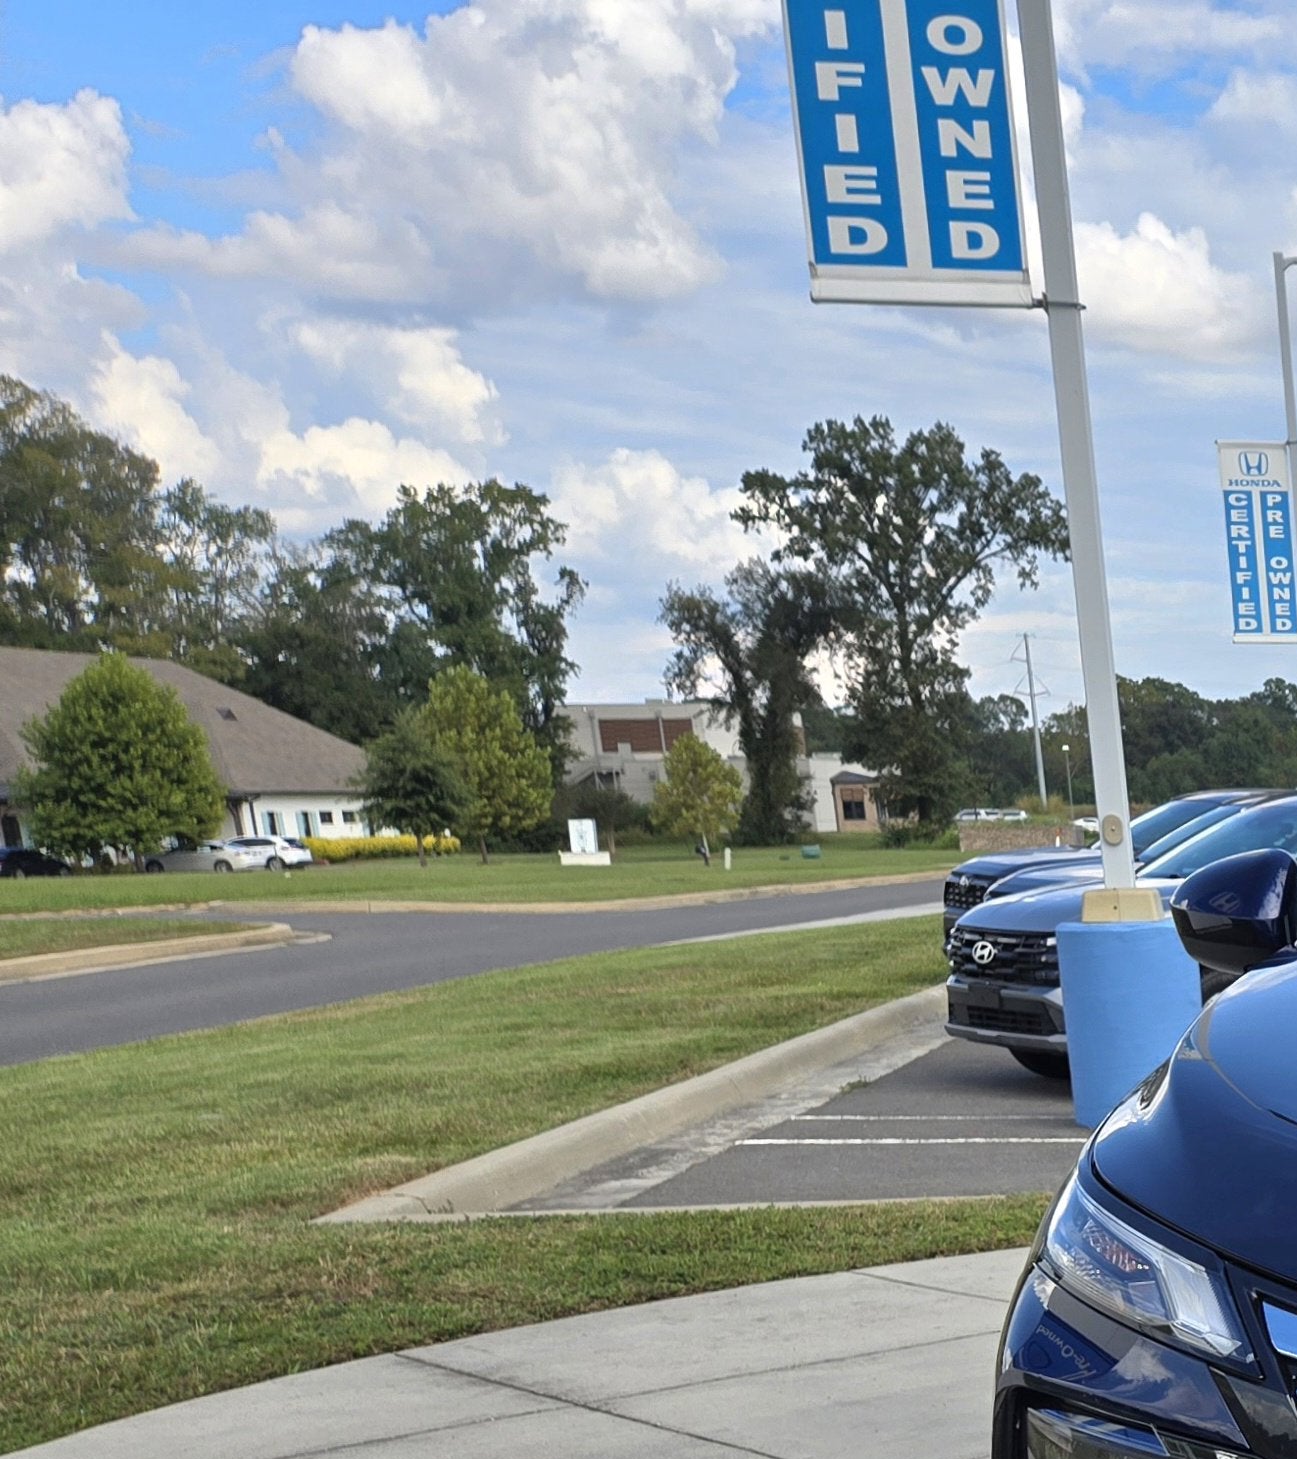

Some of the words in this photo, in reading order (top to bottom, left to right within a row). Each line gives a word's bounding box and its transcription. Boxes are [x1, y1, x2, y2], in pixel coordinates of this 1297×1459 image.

[921, 15, 1000, 260] OWNED
[1228, 479, 1282, 488] HONDA
[1266, 494, 1285, 539] PRE
[1228, 493, 1258, 631] CERTIFIED
[1268, 556, 1293, 631] OWNED
